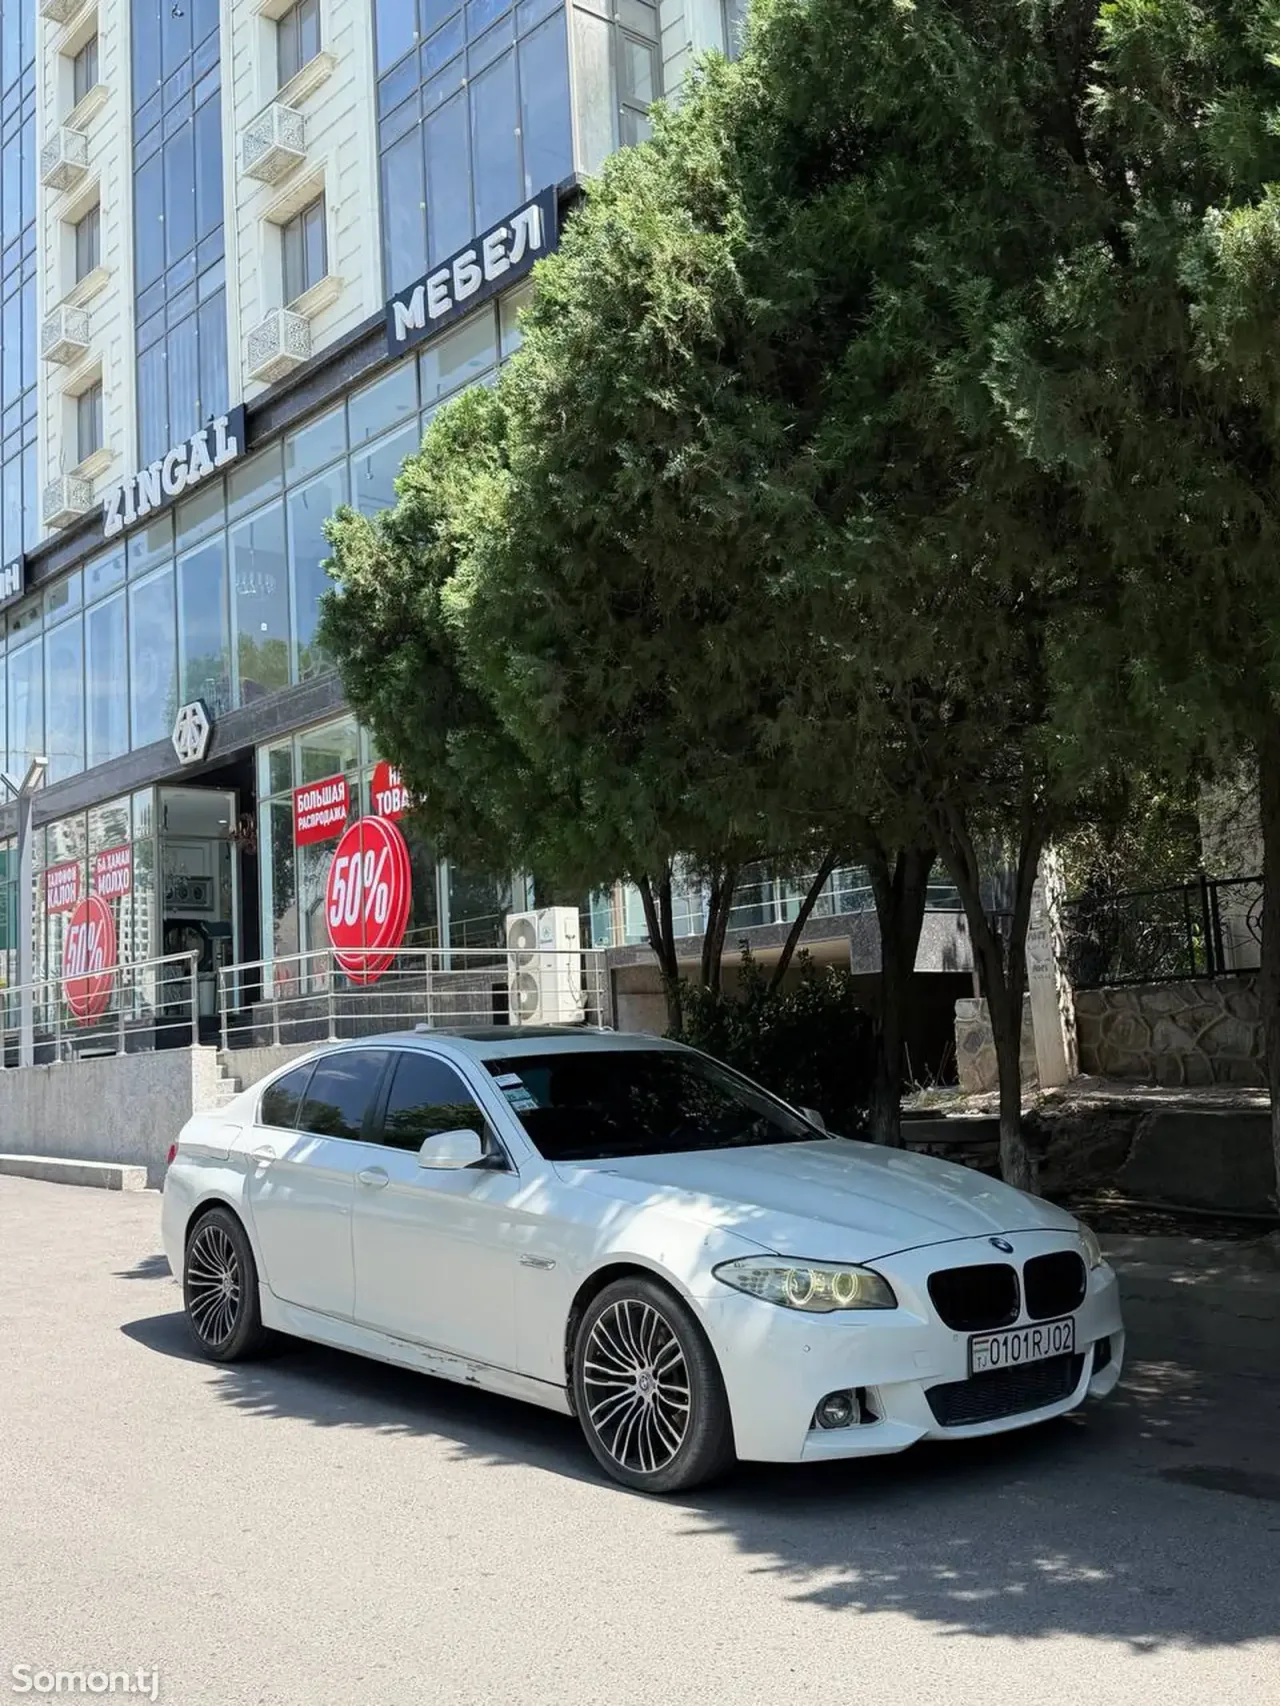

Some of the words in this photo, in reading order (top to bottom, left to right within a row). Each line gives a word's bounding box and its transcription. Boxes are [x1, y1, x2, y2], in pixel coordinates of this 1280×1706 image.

[393, 204, 542, 341] МЕБЕЛ
[102, 415, 238, 538] ZINGAL
[297, 781, 345, 813] БОЛЬШАЯ
[297, 804, 347, 832] РАСПРОДАЖА
[47, 880, 77, 909] КАЛОН
[330, 846, 389, 928] 50%
[66, 919, 103, 979] 50%
[977, 1355, 988, 1369] TJ
[989, 1323, 1072, 1365] 0101RJ02
